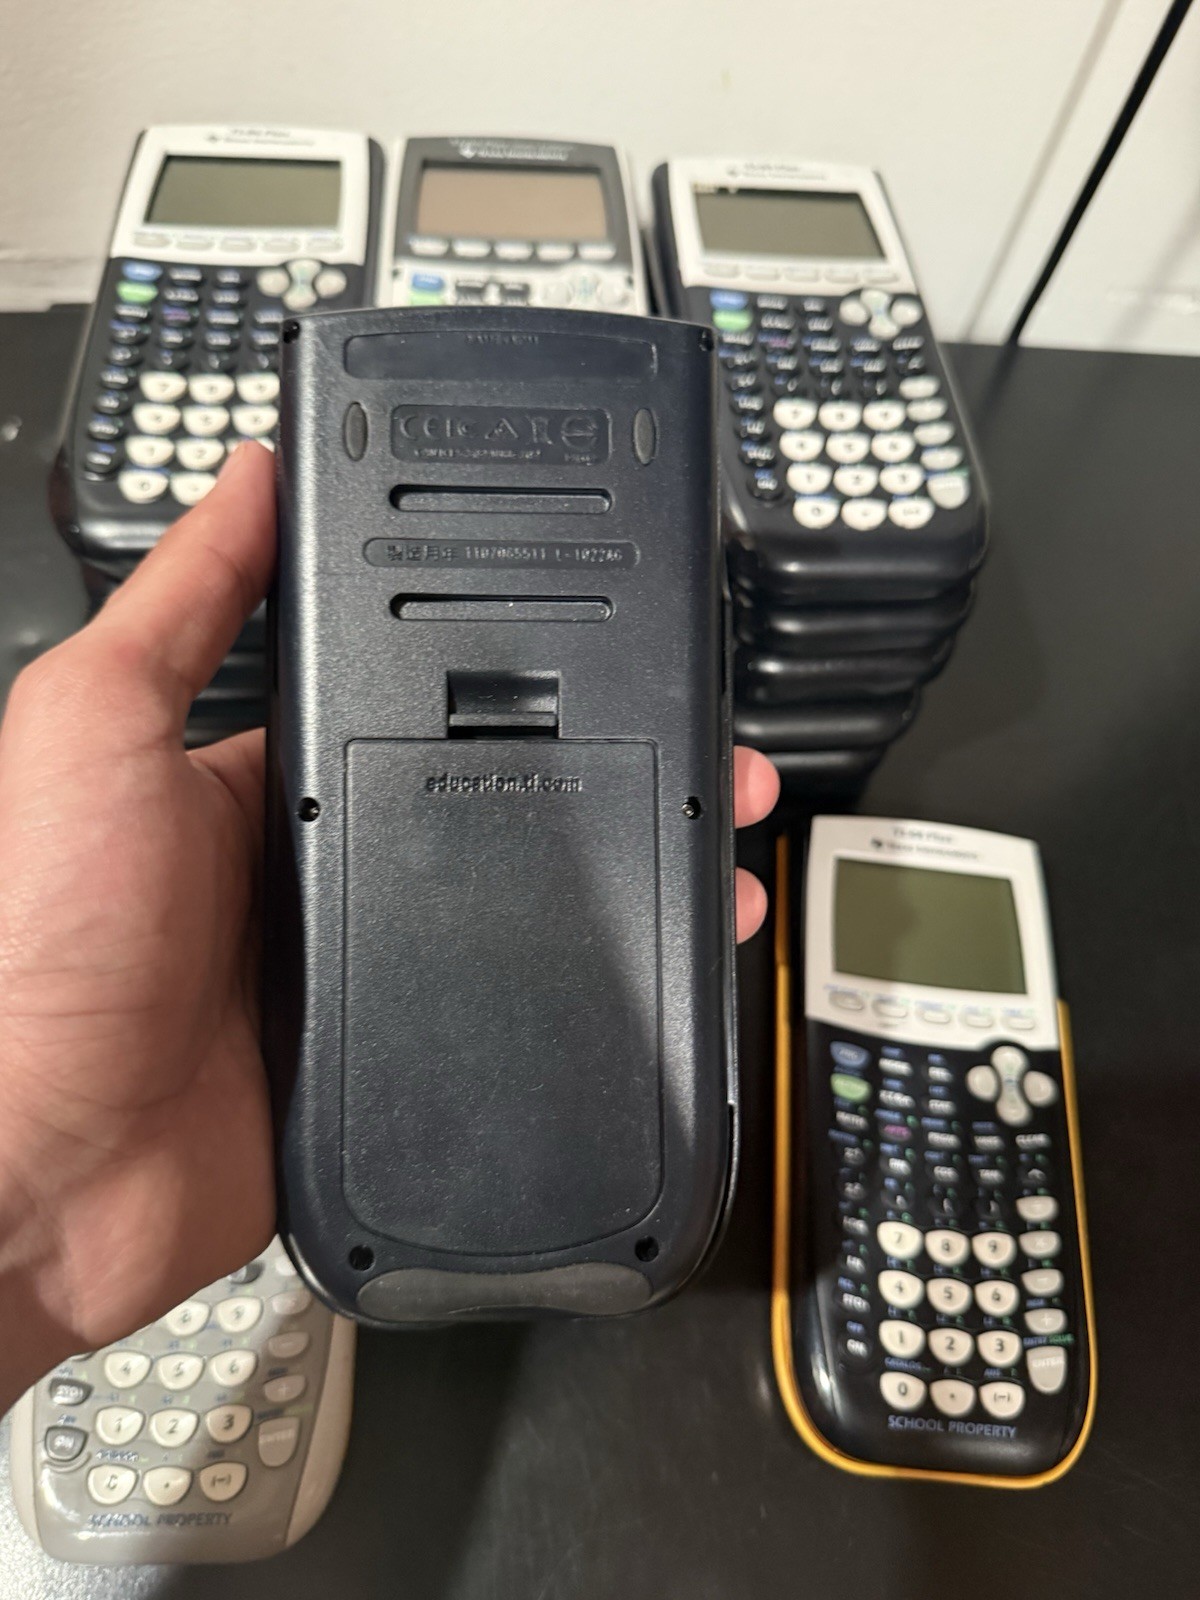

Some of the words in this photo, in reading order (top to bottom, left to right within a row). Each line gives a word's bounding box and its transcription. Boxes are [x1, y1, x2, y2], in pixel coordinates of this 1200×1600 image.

[426, 773, 582, 792] education.ti.com
[222, 1413, 235, 1431] 3
[887, 1414, 945, 1432] SCHOOL
[948, 1420, 1018, 1438] PROPERTY
[156, 1511, 233, 1526] PROPERTY
